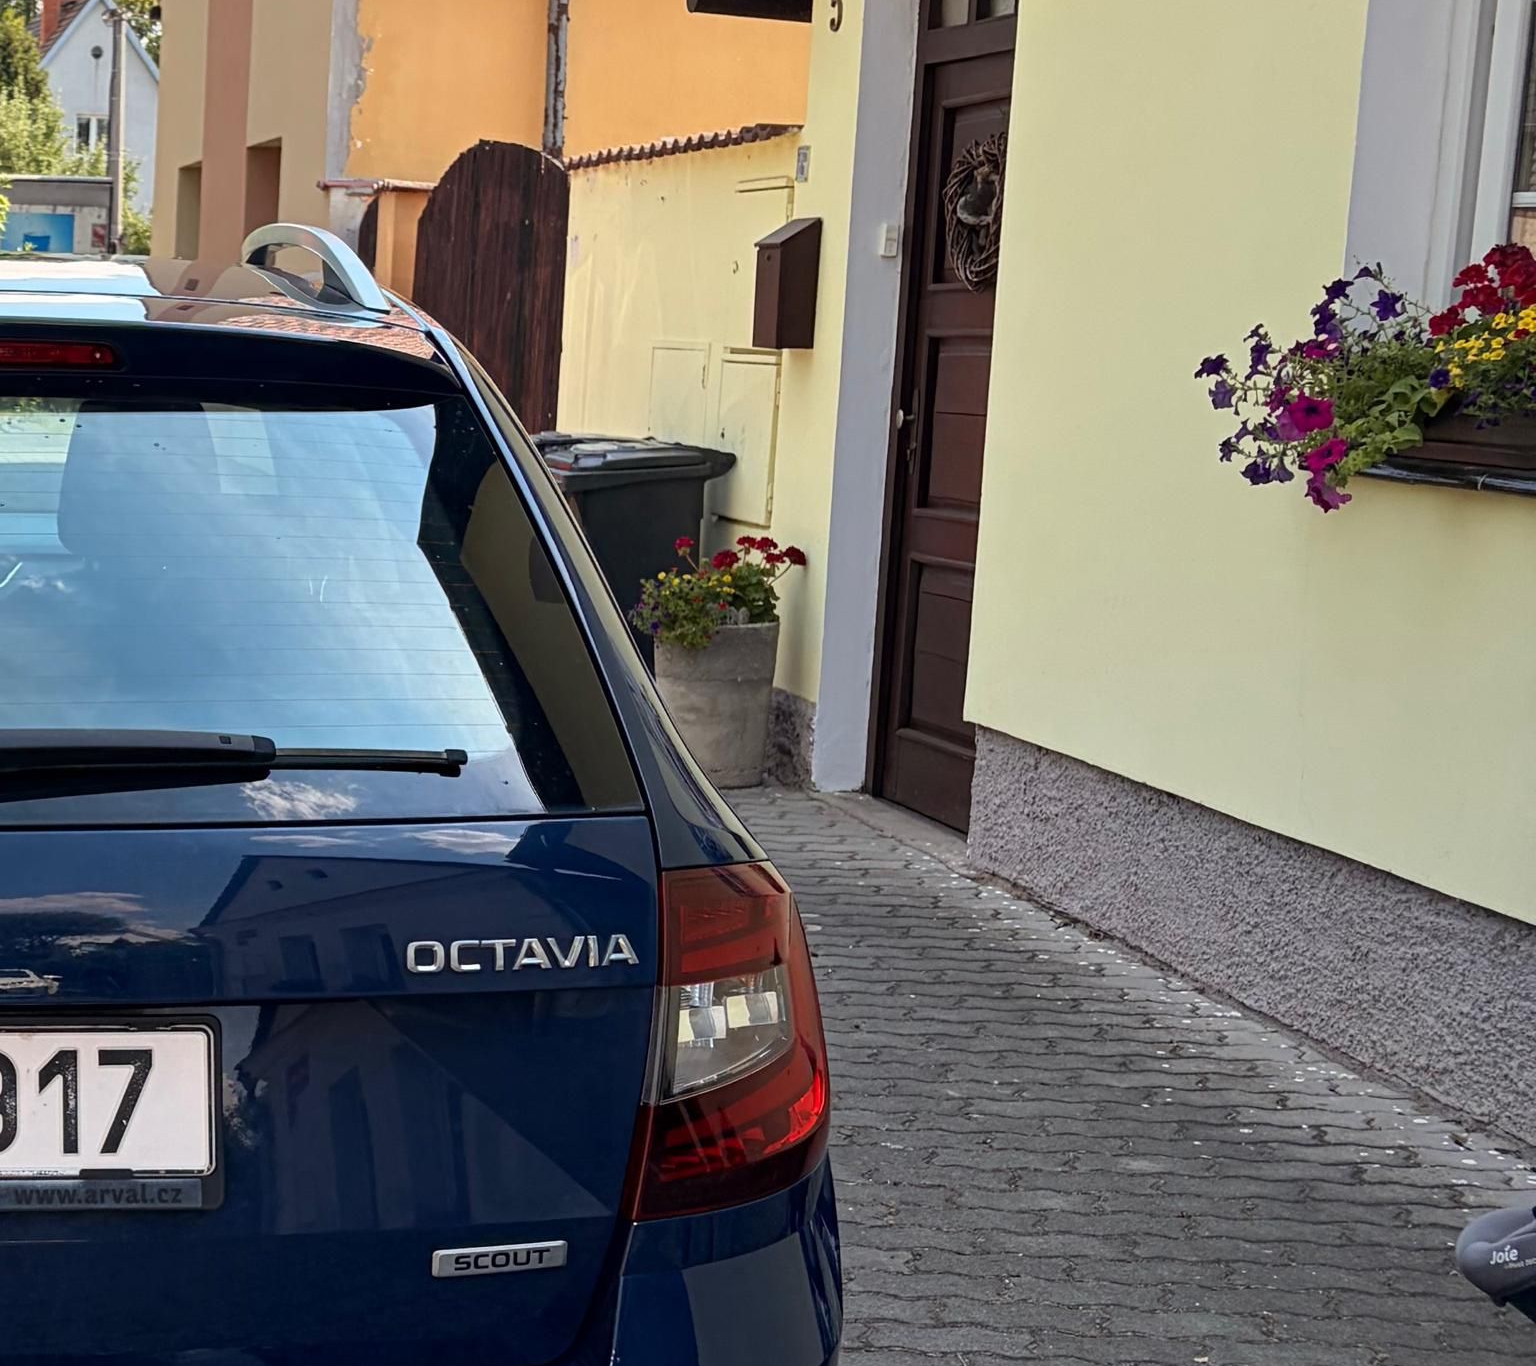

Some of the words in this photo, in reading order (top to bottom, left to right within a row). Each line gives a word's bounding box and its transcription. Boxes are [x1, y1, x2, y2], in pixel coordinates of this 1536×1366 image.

[406, 934, 640, 973] OCTAVIA
[13, 1184, 183, 1206] www.arval.cz
[454, 1249, 551, 1271] SCOUT
[1489, 1245, 1519, 1265] Joie
